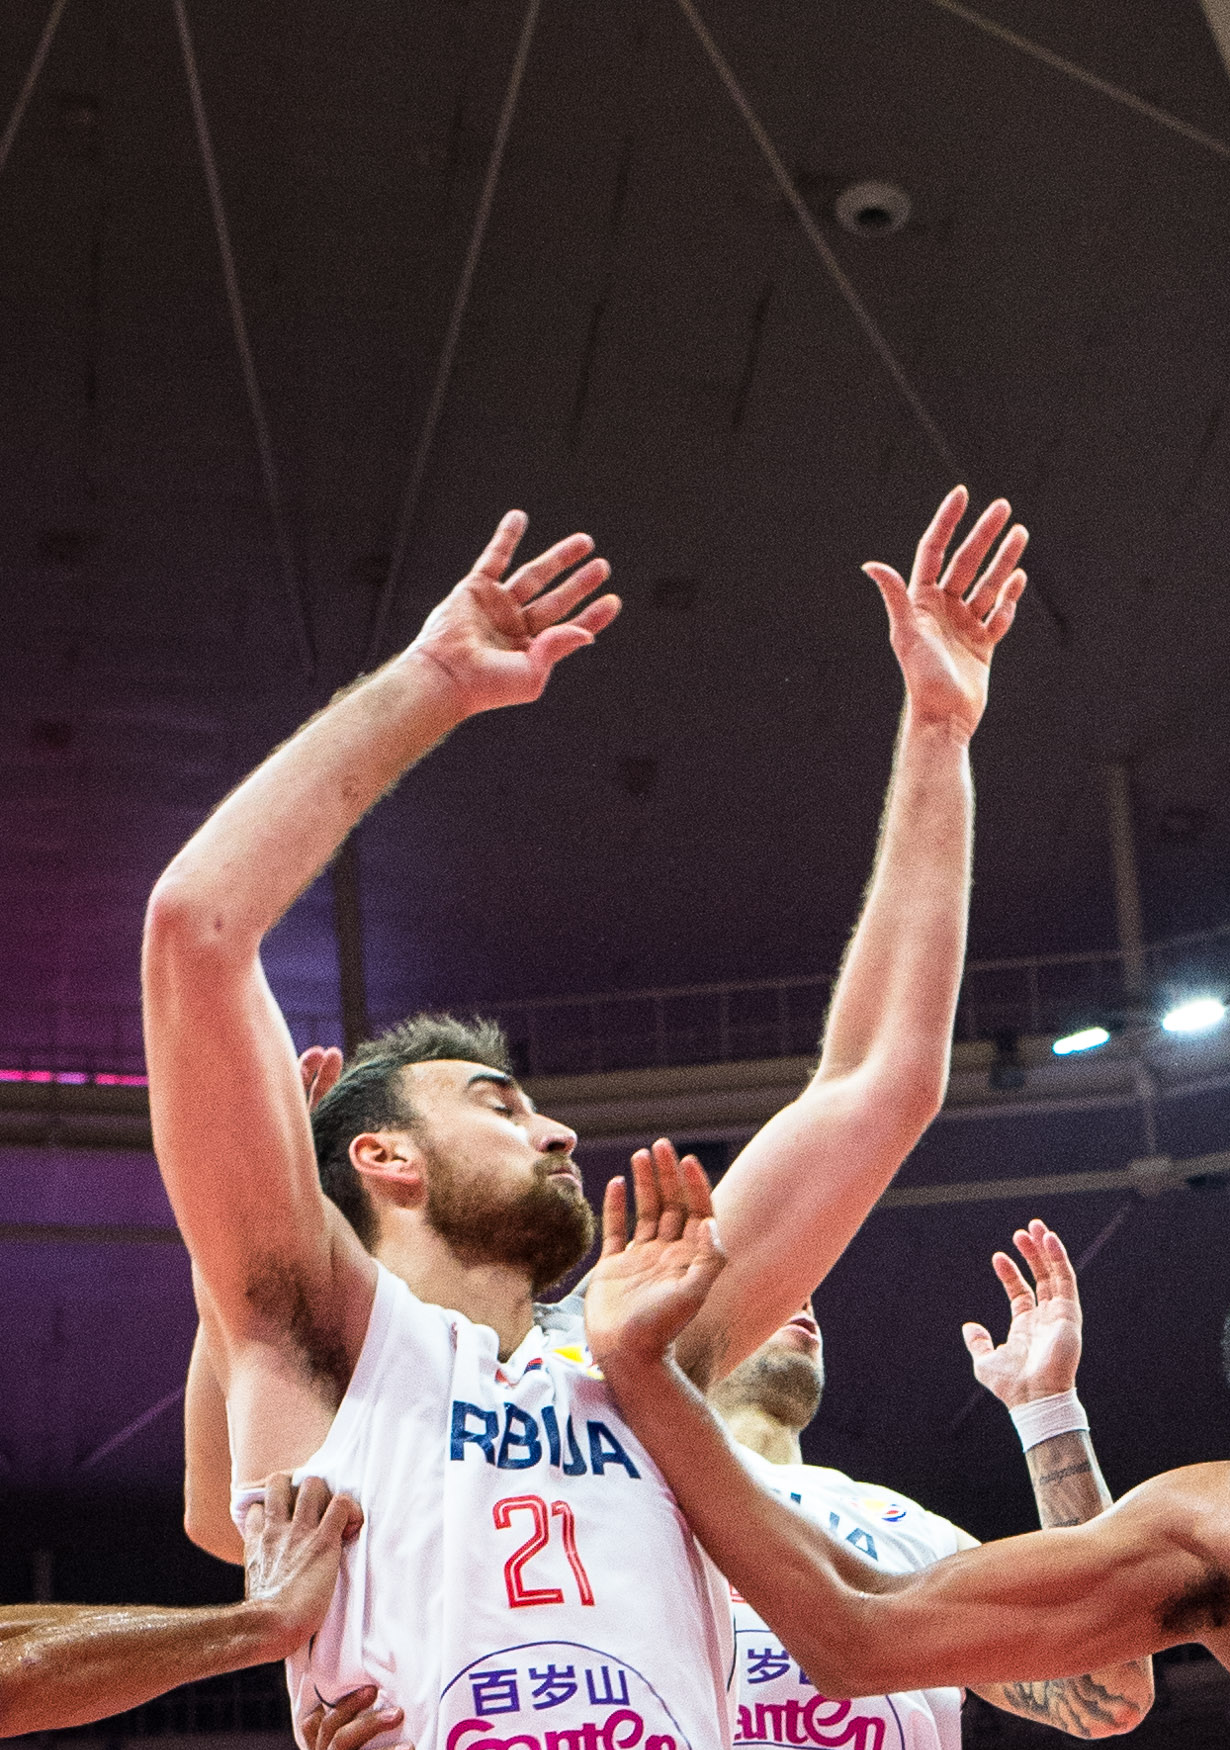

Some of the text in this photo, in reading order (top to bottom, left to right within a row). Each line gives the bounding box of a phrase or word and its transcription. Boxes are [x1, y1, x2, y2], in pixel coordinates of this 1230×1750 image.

[492, 1494, 596, 1608] 21
[468, 1665, 631, 1717] 百岁山
